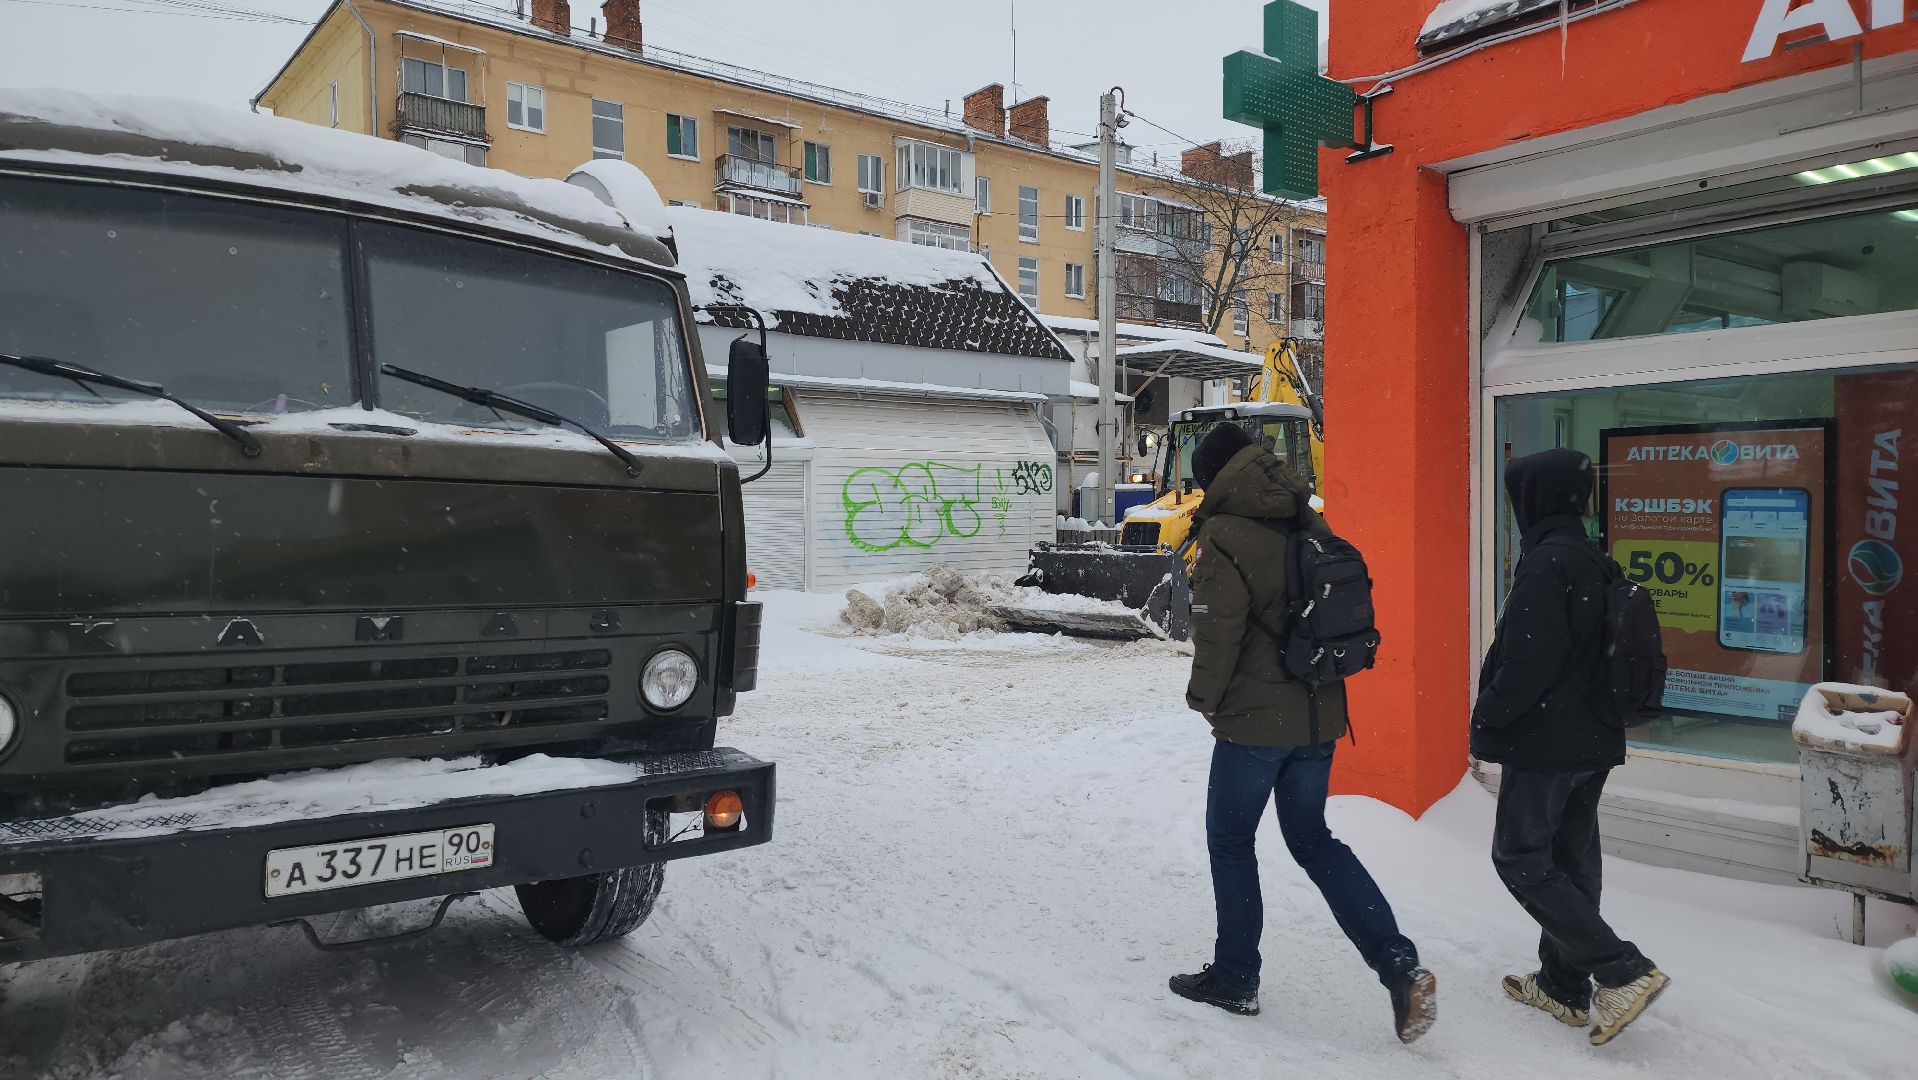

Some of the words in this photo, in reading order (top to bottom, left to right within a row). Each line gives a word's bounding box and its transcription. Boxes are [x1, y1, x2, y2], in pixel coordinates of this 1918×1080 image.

[1627, 445, 1709, 461] АПТЕКА
[1740, 444, 1799, 460] ВИТА
[1865, 428, 1903, 541] ВИТА
[1615, 498, 1713, 513] КЭШБЭК
[1627, 551, 1715, 586] 50%
[1649, 588, 1688, 598] ОВАРЫ
[448, 830, 481, 856] 90
[445, 854, 470, 867] RUS
